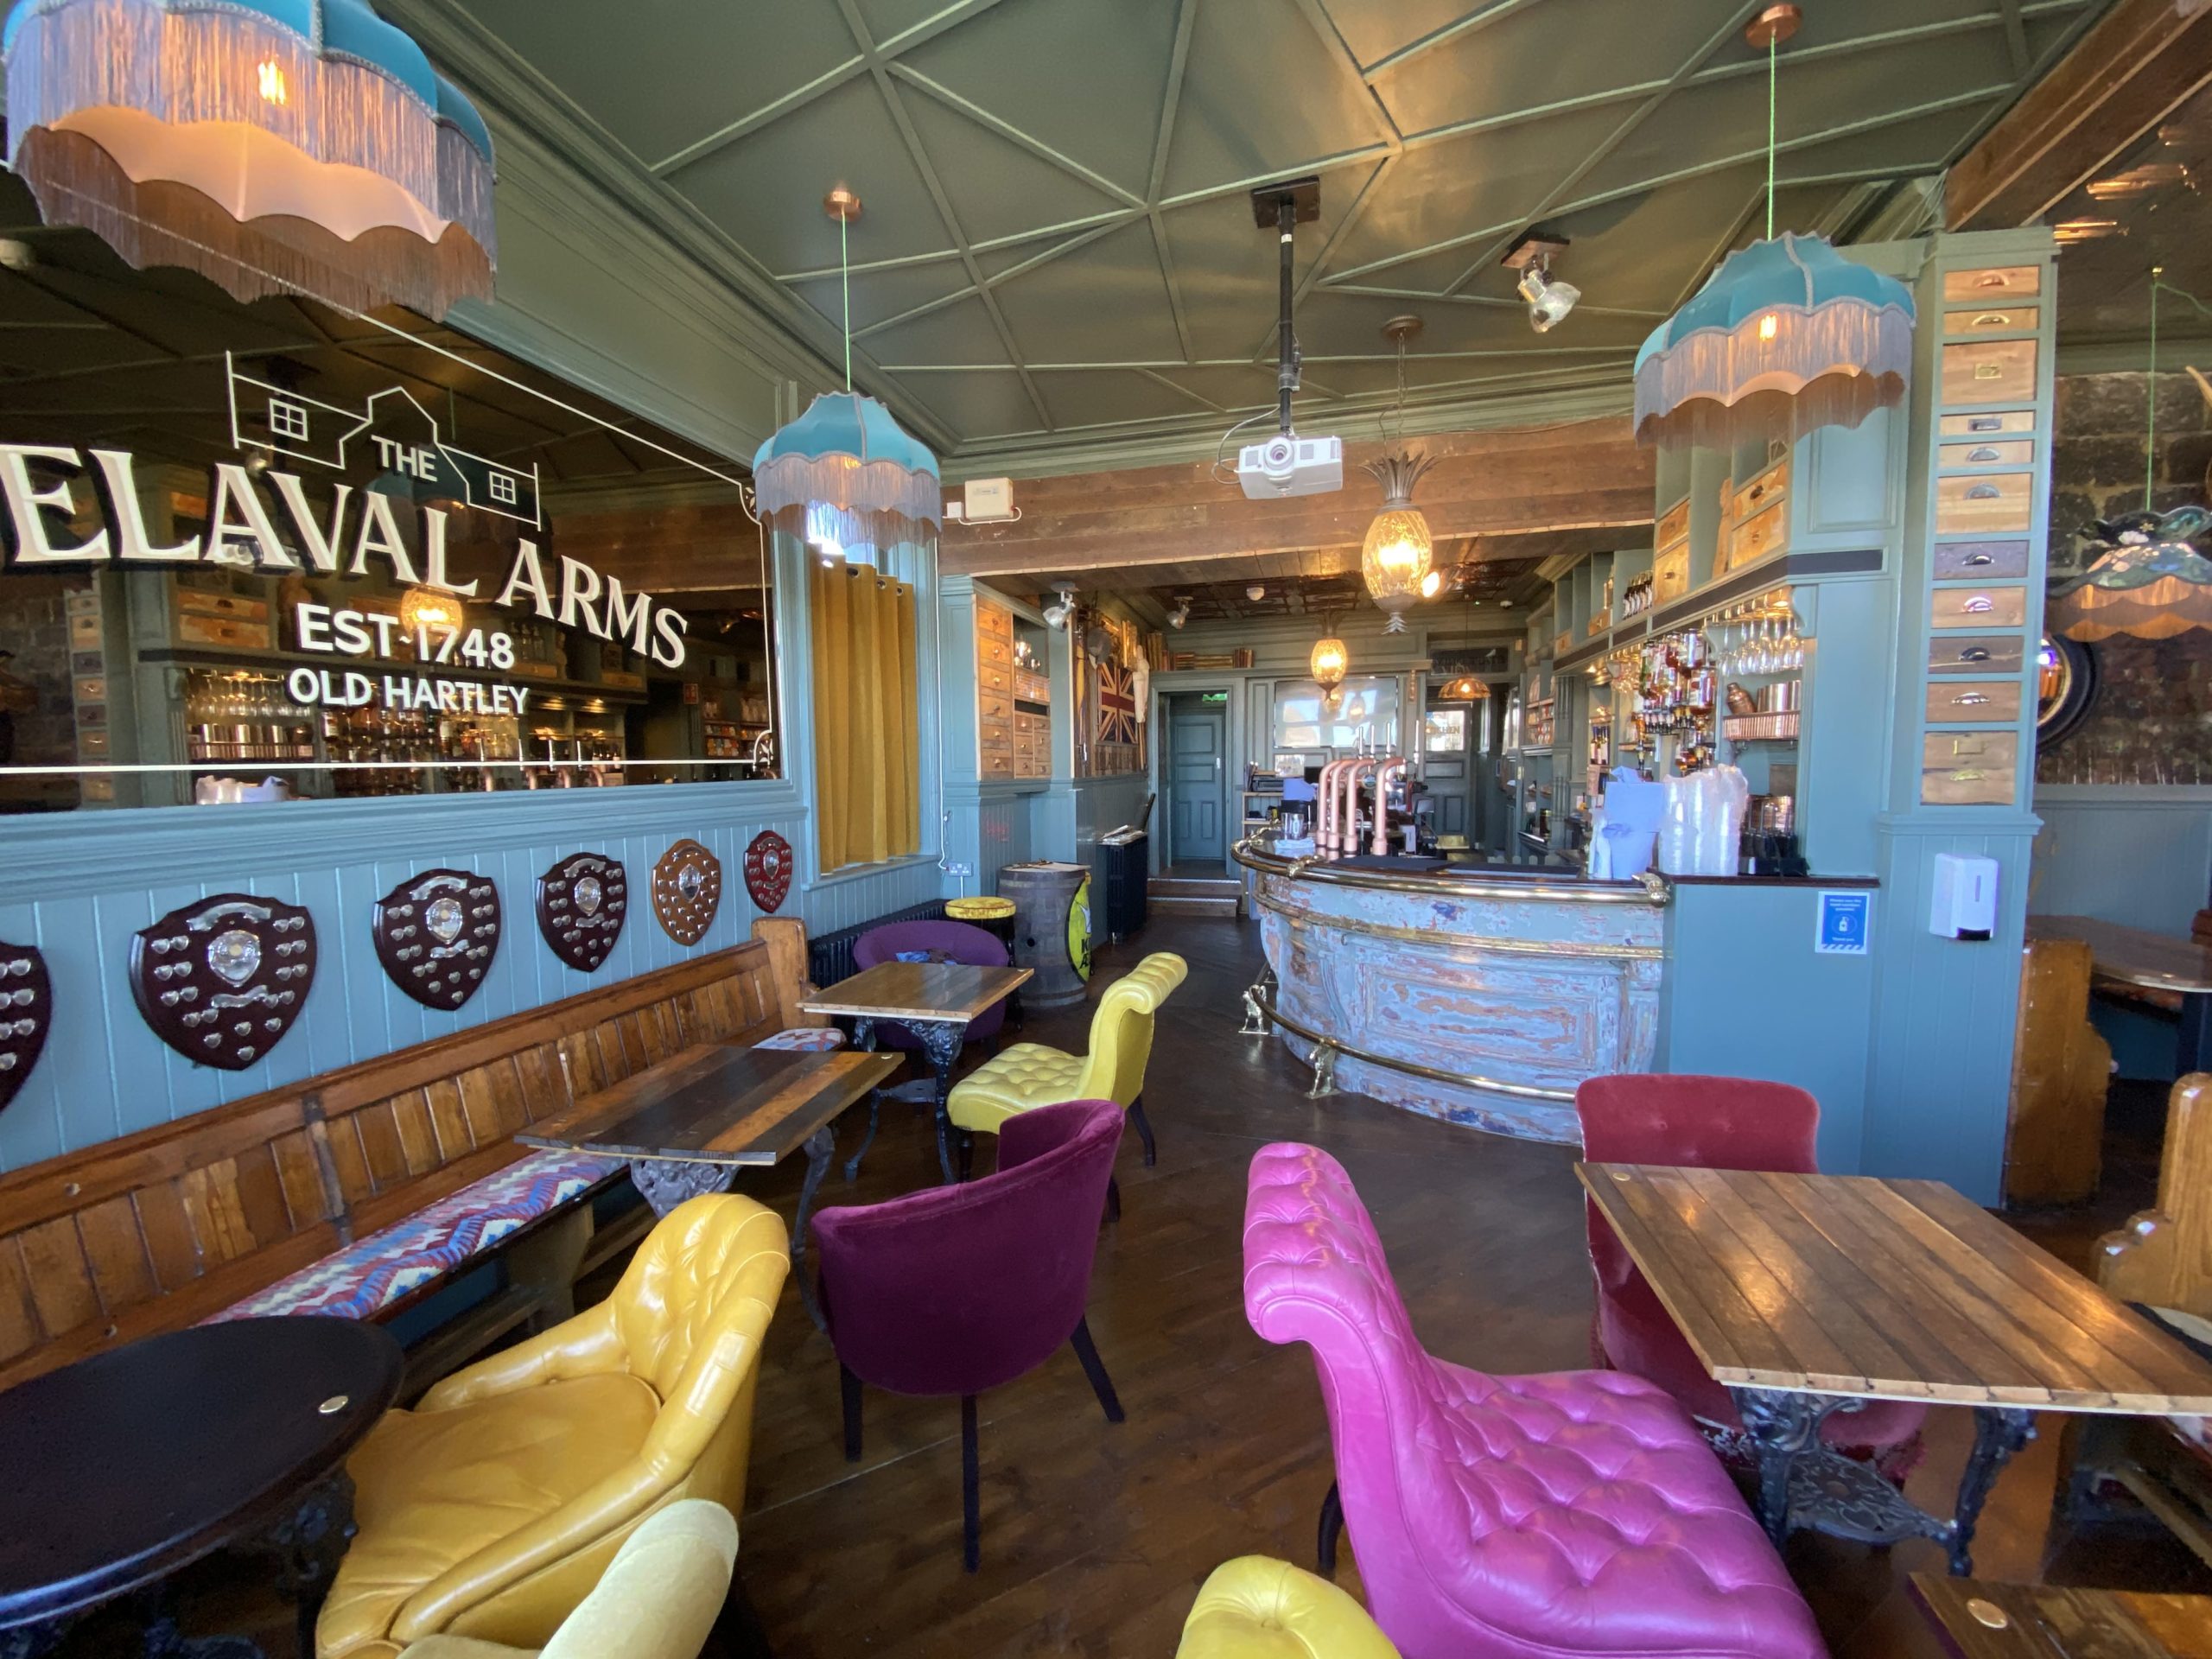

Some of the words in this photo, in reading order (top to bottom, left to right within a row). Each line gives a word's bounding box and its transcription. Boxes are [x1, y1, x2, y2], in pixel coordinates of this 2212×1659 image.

[371, 435, 438, 482] THE
[0, 444, 478, 596] ELAVAL
[495, 537, 688, 669] ARMS
[288, 667, 372, 706] OLD
[381, 675, 529, 715] HARTLEY
